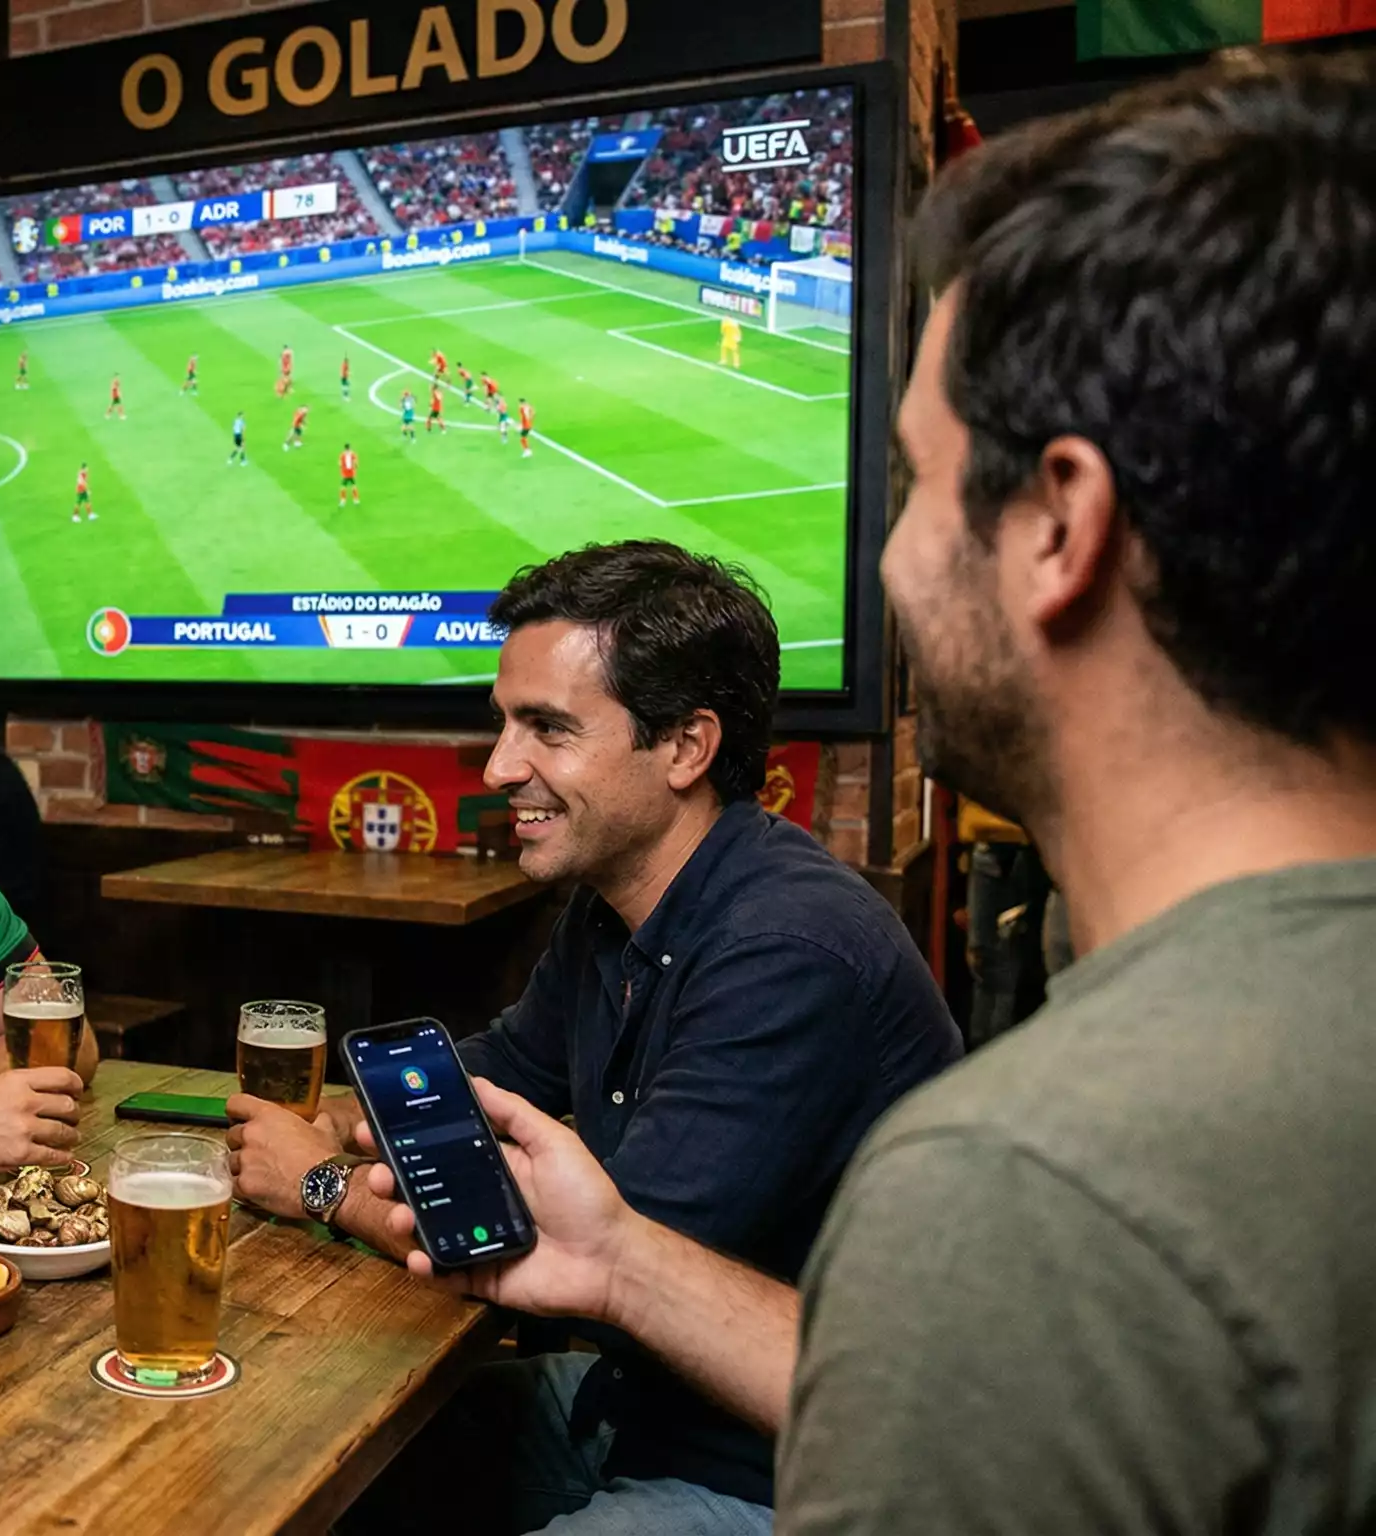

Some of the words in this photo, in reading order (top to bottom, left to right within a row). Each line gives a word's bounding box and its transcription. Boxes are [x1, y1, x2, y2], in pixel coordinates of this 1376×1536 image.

[121, 53, 183, 130] O
[208, 0, 629, 116] GOLADO
[724, 129, 808, 163] UEFA
[88, 215, 126, 236] POR
[199, 201, 240, 222] ADR
[294, 194, 314, 208] 78
[292, 593, 354, 612] ESTÁDIO
[355, 596, 376, 611] DO
[378, 592, 442, 612] DRAGÃO
[174, 622, 276, 642] PORTUGAL
[345, 624, 353, 640] 1
[376, 624, 388, 640] 0
